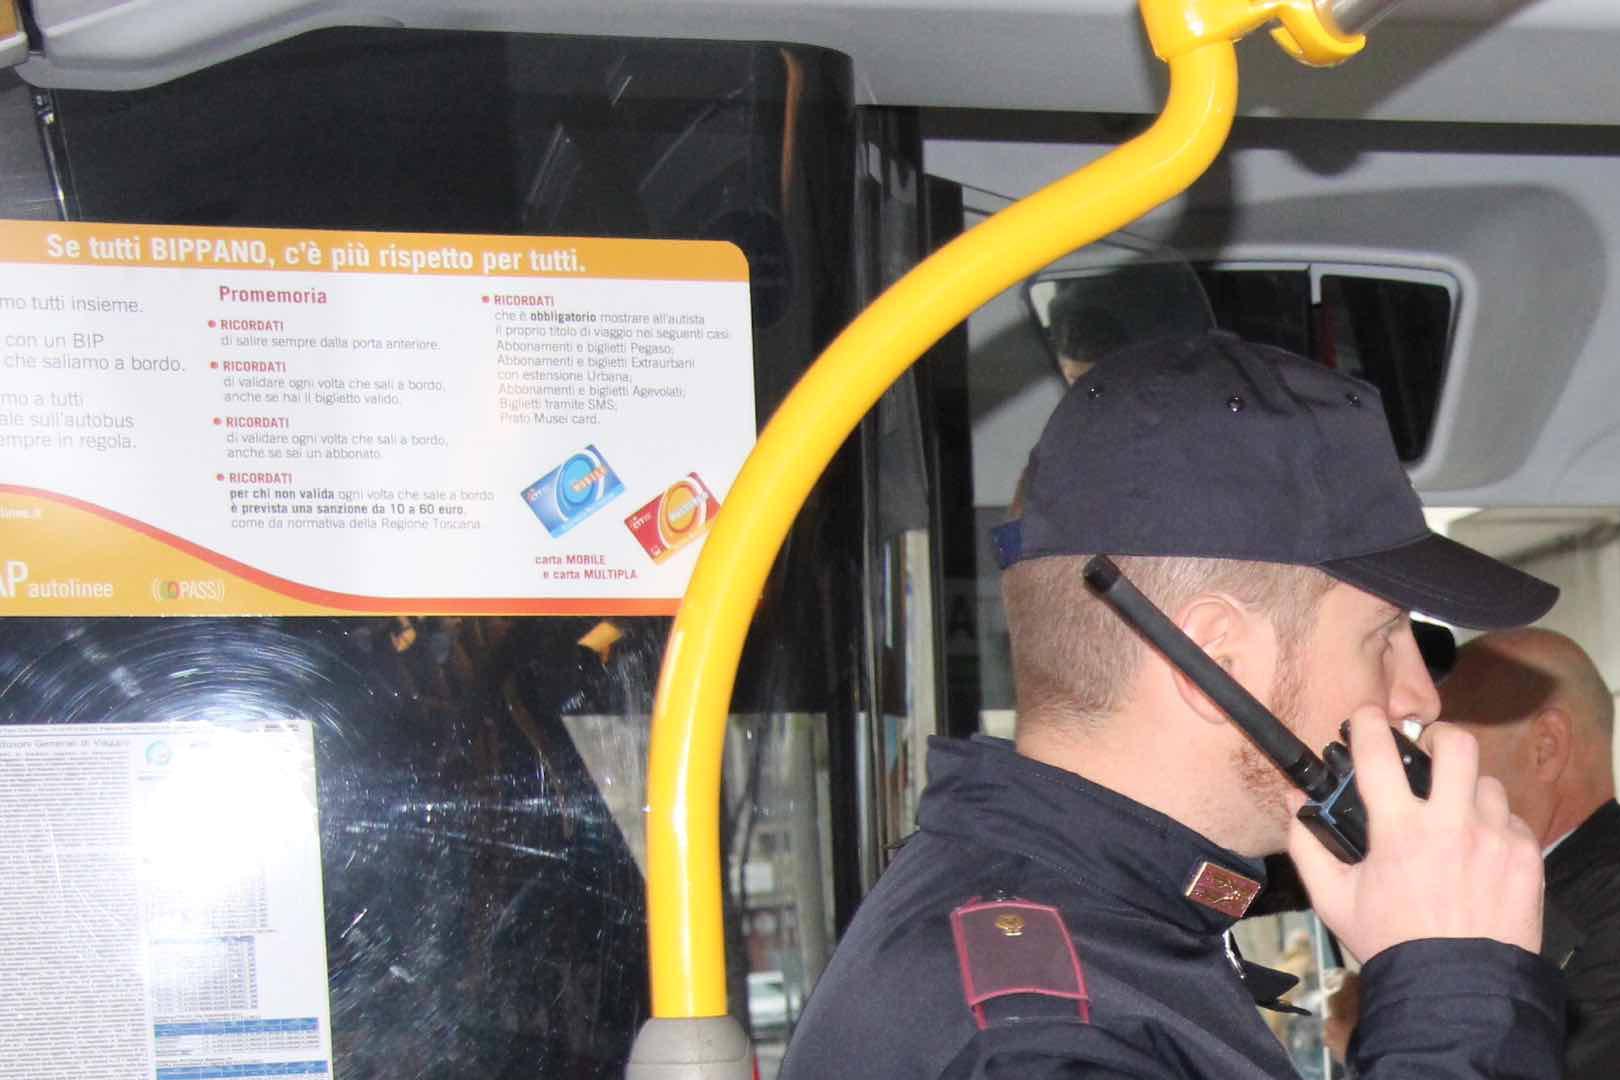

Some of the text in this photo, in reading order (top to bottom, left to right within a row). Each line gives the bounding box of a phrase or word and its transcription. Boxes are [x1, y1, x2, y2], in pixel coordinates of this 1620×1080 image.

[47, 233, 587, 275] Se tutti BIPPANO, c'è più rispetto per tutti.
[219, 285, 327, 304] Promemoria
[494, 294, 554, 307] RICORDATI
[0, 296, 144, 313] mo tutti insieme.
[495, 309, 517, 321] che
[530, 310, 597, 324] obbligatorio
[600, 313, 650, 325] mostrare
[653, 312, 705, 326] all'autista
[220, 320, 284, 332] RICORDATI
[506, 325, 546, 338] proprio
[550, 325, 577, 337] titolo
[580, 325, 591, 338] di
[594, 326, 633, 341] viaggio
[656, 327, 704, 342] seguenti
[6, 332, 104, 349] con un BIP
[220, 335, 232, 346] di
[236, 335, 268, 347] salire
[271, 338, 317, 351] sempre
[320, 336, 349, 349] dalla
[352, 339, 383, 352] porta
[496, 340, 573, 352] Abbonamenti
[576, 343, 584, 352] e
[587, 341, 627, 355] biglietti
[41, 353, 109, 370] saliamo
[115, 359, 125, 371] a
[131, 355, 186, 373] bordo.
[223, 360, 287, 372] RICORDATI
[497, 354, 695, 370] Abbonamenti e biglietti Extraurbani
[224, 375, 235, 387] di
[239, 375, 285, 388] validare
[288, 377, 315, 391] ogni
[318, 377, 345, 389] volta
[348, 377, 371, 389] che
[374, 378, 394, 390] sali
[397, 381, 405, 390] a
[497, 371, 520, 382] con
[522, 371, 584, 383] estensione
[0, 391, 84, 408] mo a tutti
[223, 390, 262, 403] anche
[265, 393, 280, 403] se
[314, 391, 361, 406] biglietto
[498, 384, 575, 397] Abbonamenti
[589, 385, 630, 400] biglietti
[499, 399, 541, 413] Biglietti
[544, 399, 585, 412] tramite
[30, 410, 135, 430] sull'autobus
[226, 417, 289, 429] RICORDATI
[534, 413, 569, 425] Musei
[0, 432, 137, 452] empre in regola.
[226, 432, 239, 444] di
[241, 432, 289, 444] validare
[291, 433, 318, 447] ogni
[320, 433, 348, 445] volta
[351, 433, 374, 445] che
[377, 434, 397, 446] sali
[399, 438, 408, 447] a
[226, 447, 265, 460] anche
[268, 450, 283, 460] se
[286, 448, 303, 460] sai
[306, 449, 323, 460] un
[229, 472, 293, 484] RICORDATI
[230, 490, 249, 502] per
[252, 489, 271, 501] chi
[274, 490, 297, 502] non
[299, 489, 335, 502] valida
[338, 491, 363, 504] ogni
[366, 490, 395, 502] volta
[397, 490, 418, 502] che
[231, 503, 238, 514] è
[241, 502, 289, 516] prevista
[291, 504, 314, 515] una
[316, 503, 369, 516] sanzione
[371, 503, 386, 515] da
[390, 504, 405, 516] 10
[408, 506, 417, 516] a
[418, 504, 435, 516] 60
[231, 518, 265, 529] come
[268, 518, 284, 529] da
[287, 517, 346, 529] normativa
[349, 517, 378, 529] della
[381, 517, 430, 533] Regione
[535, 554, 606, 566] carta MOBILE
[543, 569, 638, 581] e carta MULTIPLA
[29, 579, 113, 599] autolinee
